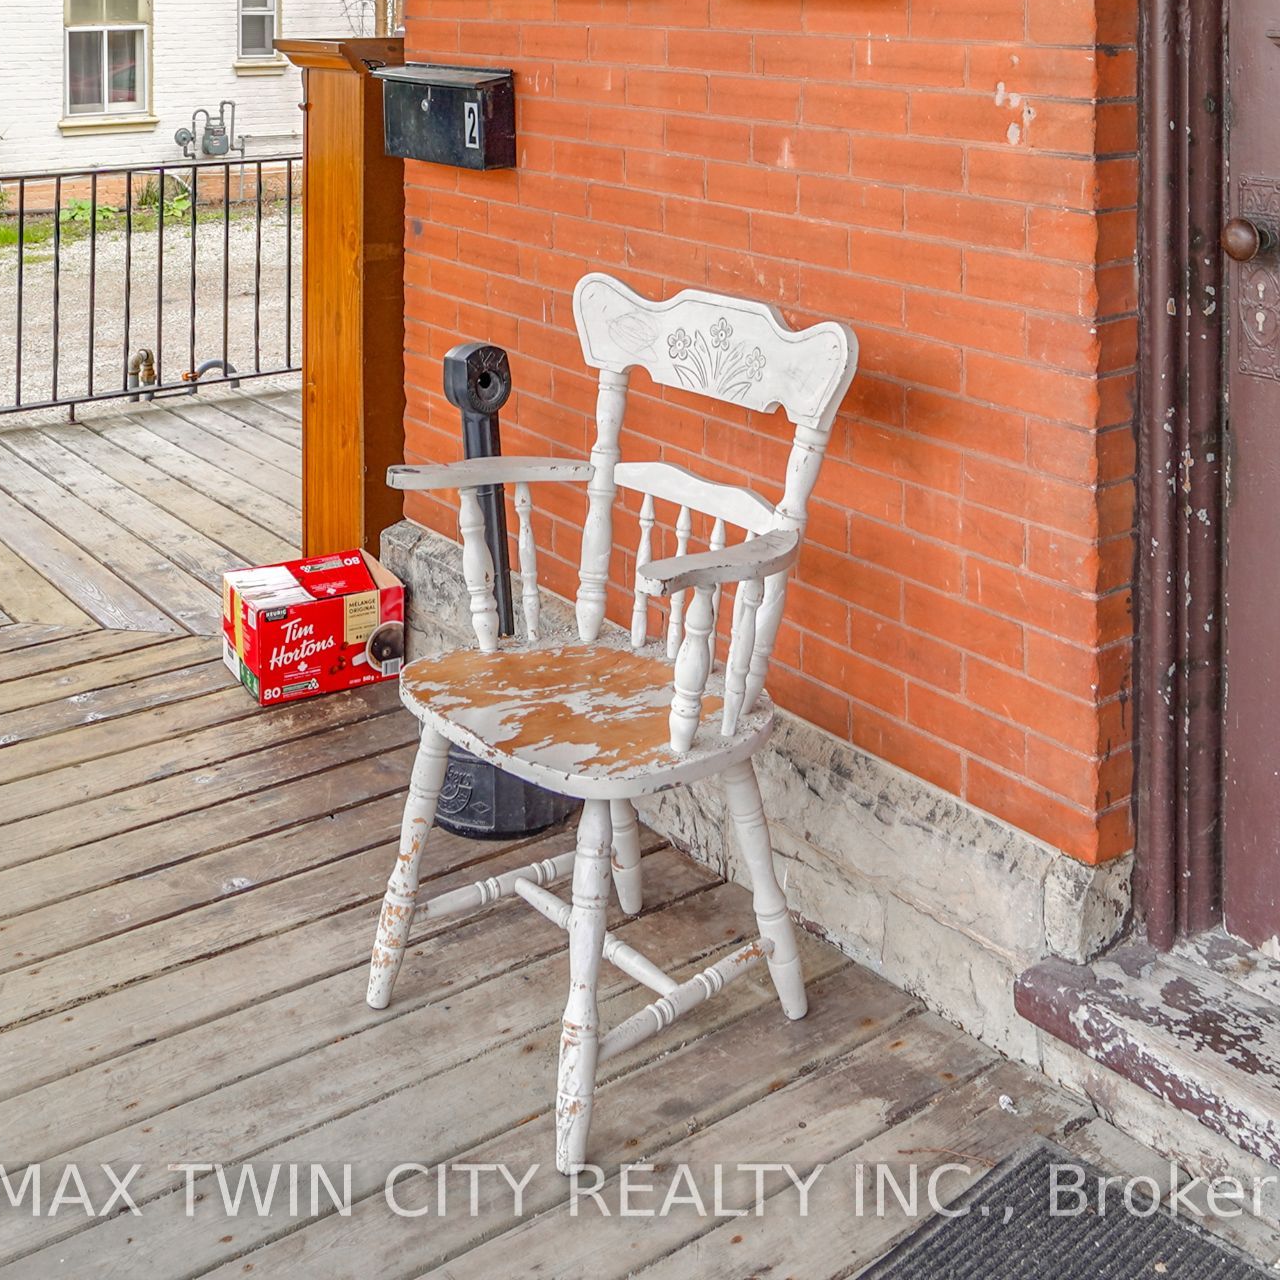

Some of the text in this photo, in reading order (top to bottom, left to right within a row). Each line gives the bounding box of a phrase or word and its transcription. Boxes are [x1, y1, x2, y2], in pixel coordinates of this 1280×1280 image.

[467, 106, 477, 145] 2
[280, 617, 315, 644] Tim
[269, 635, 334, 671] Hortons
[263, 686, 281, 700] 80
